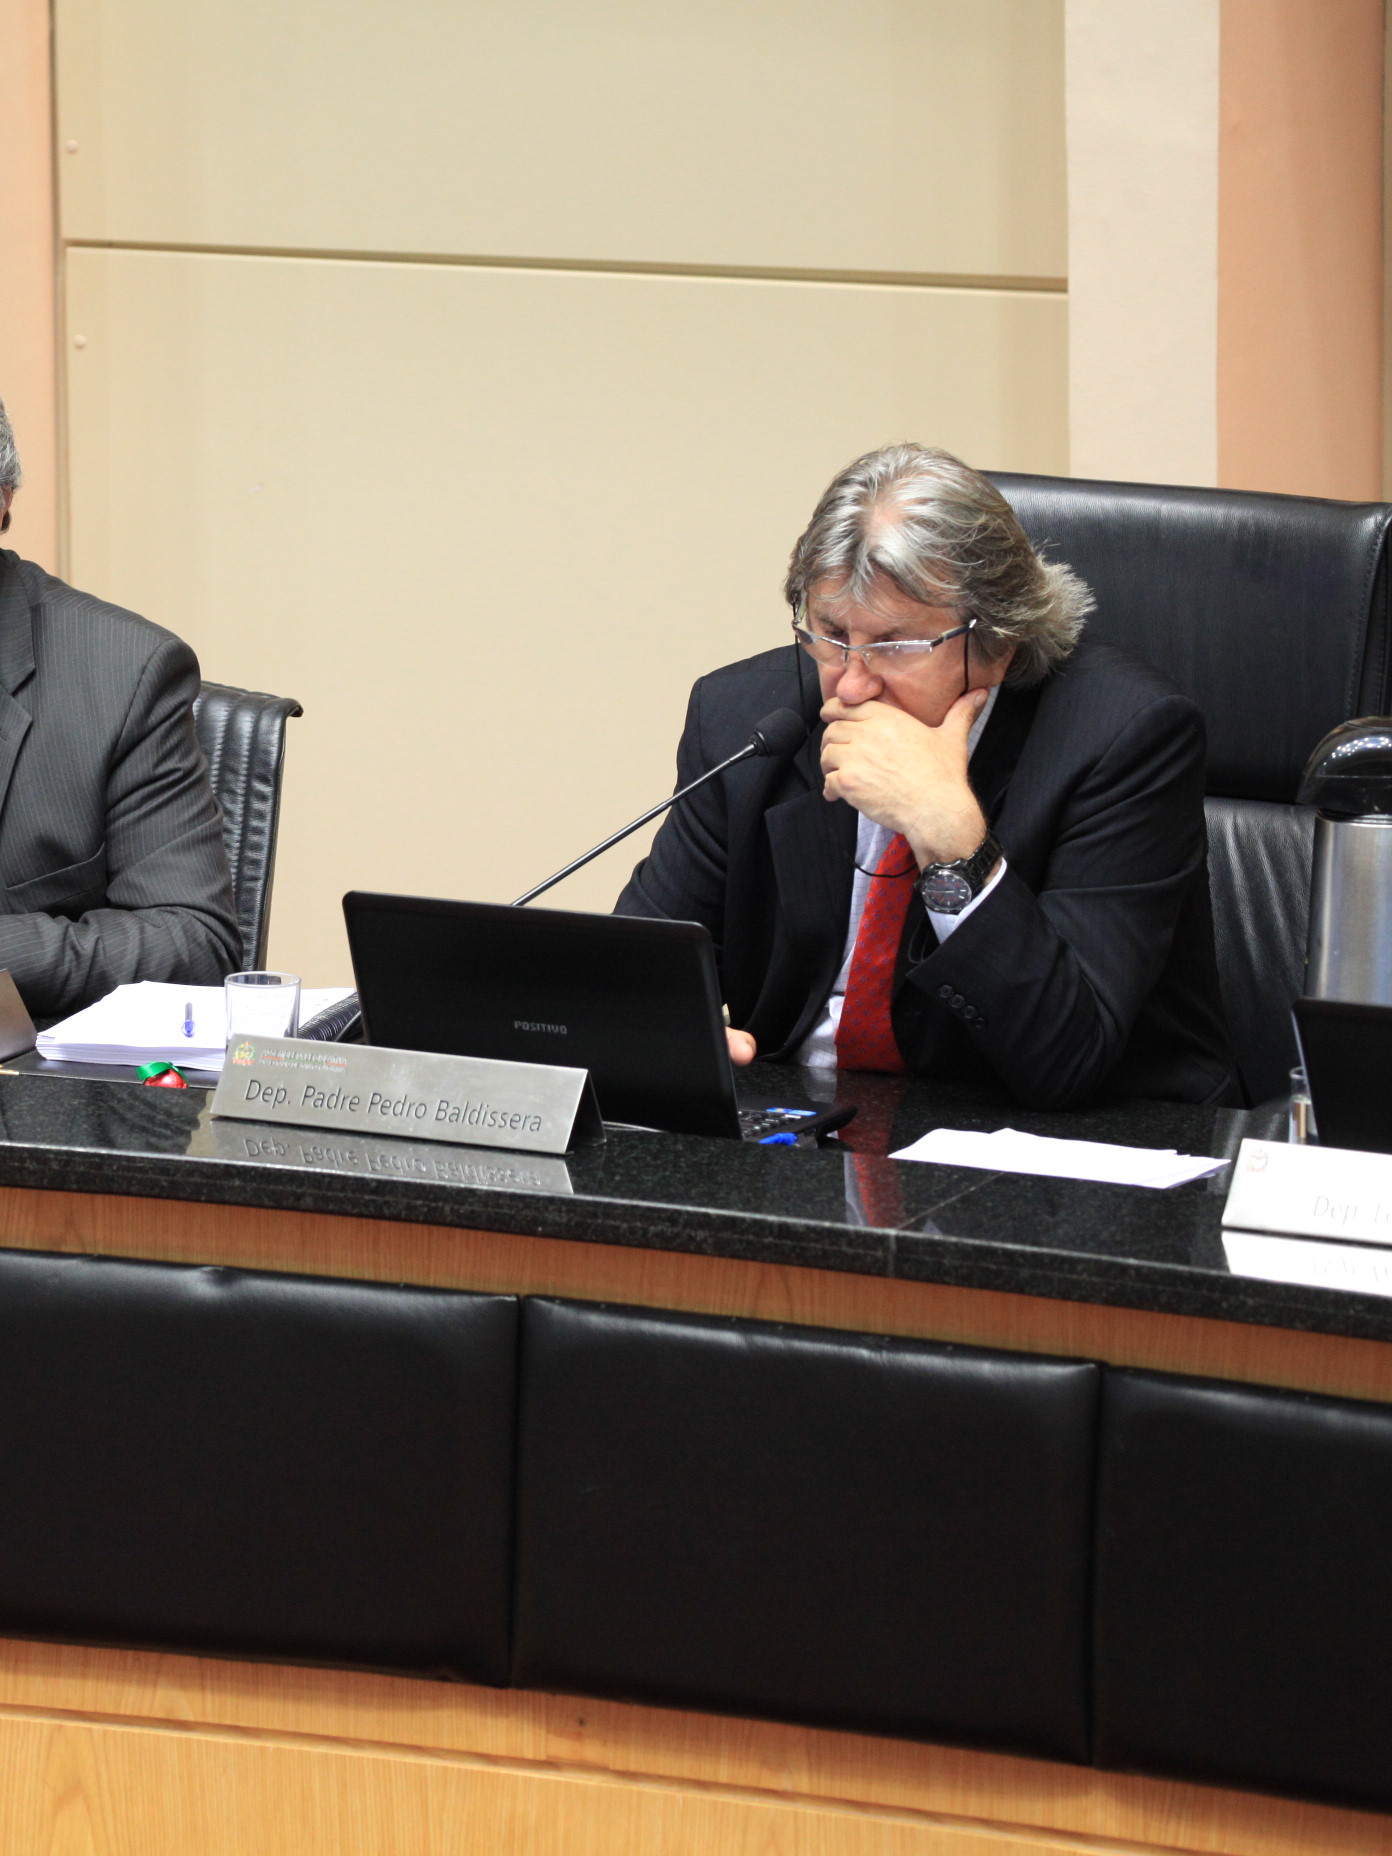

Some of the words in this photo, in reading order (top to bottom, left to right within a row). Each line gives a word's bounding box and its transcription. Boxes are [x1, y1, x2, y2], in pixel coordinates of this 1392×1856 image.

[513, 1020, 568, 1036] POSITIVO
[245, 1079, 291, 1109] Dep.
[302, 1085, 360, 1112] Padre
[367, 1092, 427, 1119] Pedro
[435, 1100, 542, 1132] Baldissera
